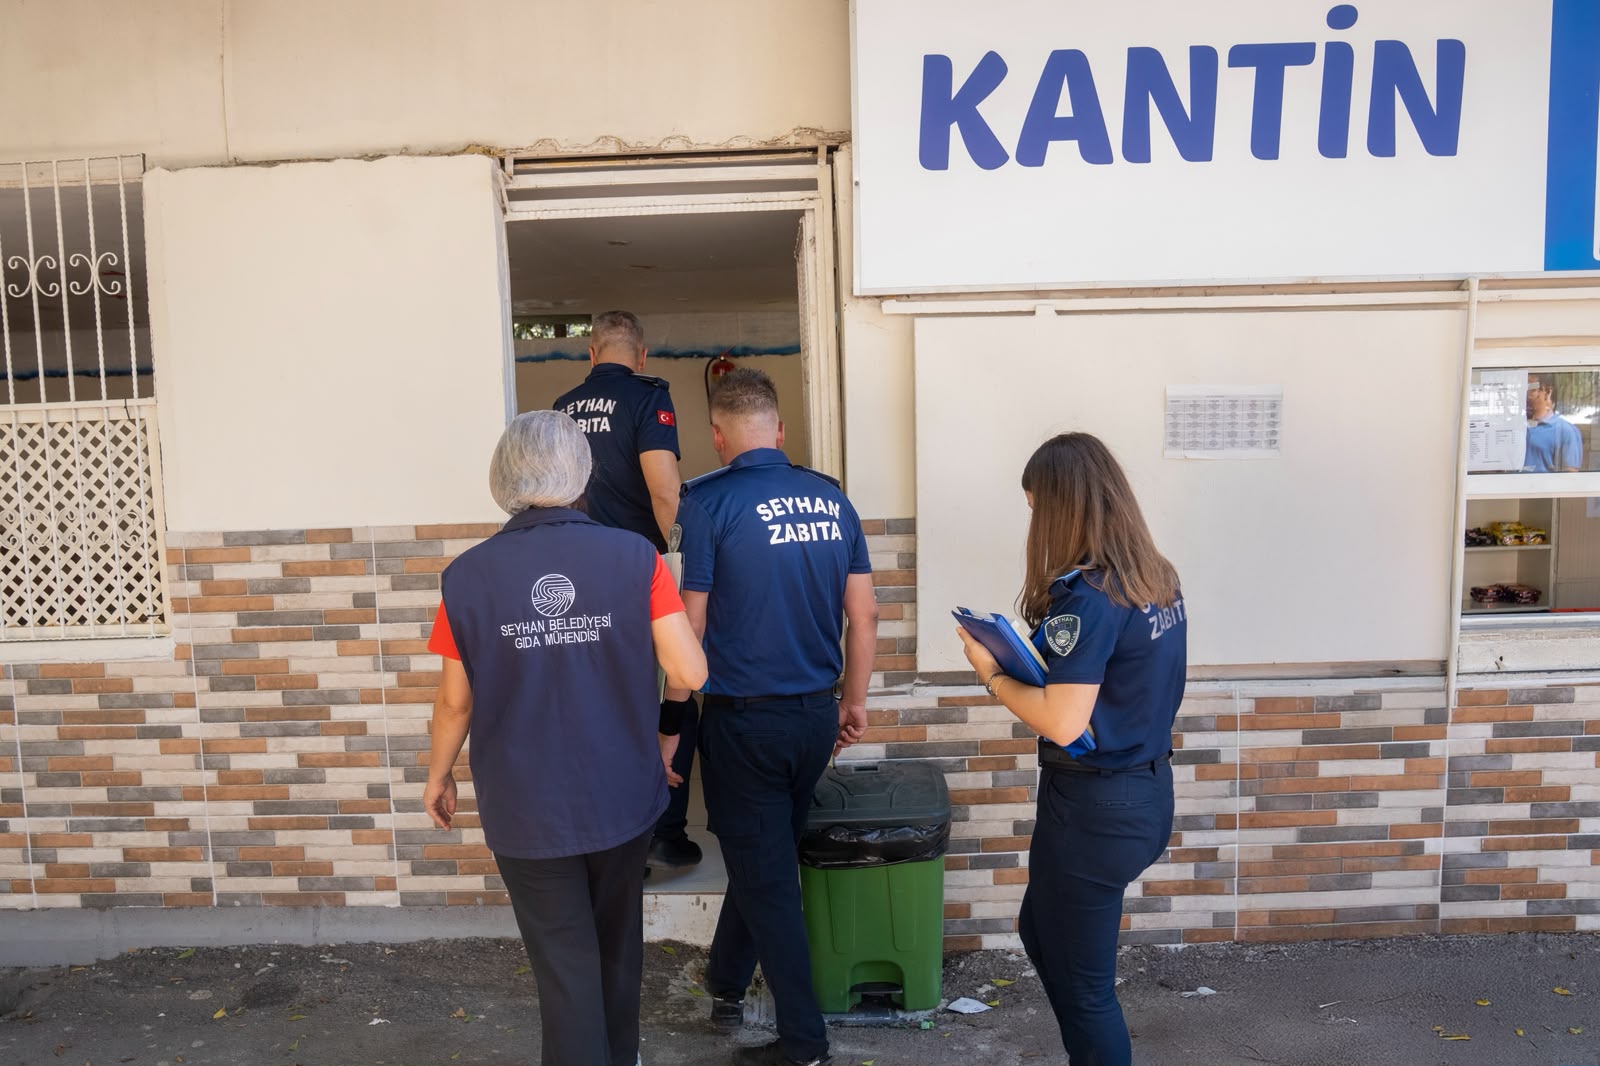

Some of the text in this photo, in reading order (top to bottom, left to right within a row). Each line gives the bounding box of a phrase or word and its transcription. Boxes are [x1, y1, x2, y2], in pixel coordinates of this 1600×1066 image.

[919, 4, 1466, 171] KANTİN
[577, 416, 611, 433] BITA
[756, 496, 840, 521] SEYHAN
[767, 521, 842, 545] ZABITA
[500, 613, 612, 636] SEYHAN BELEDİYESİ
[514, 628, 600, 648] GIDA MÜHENDİSİ
